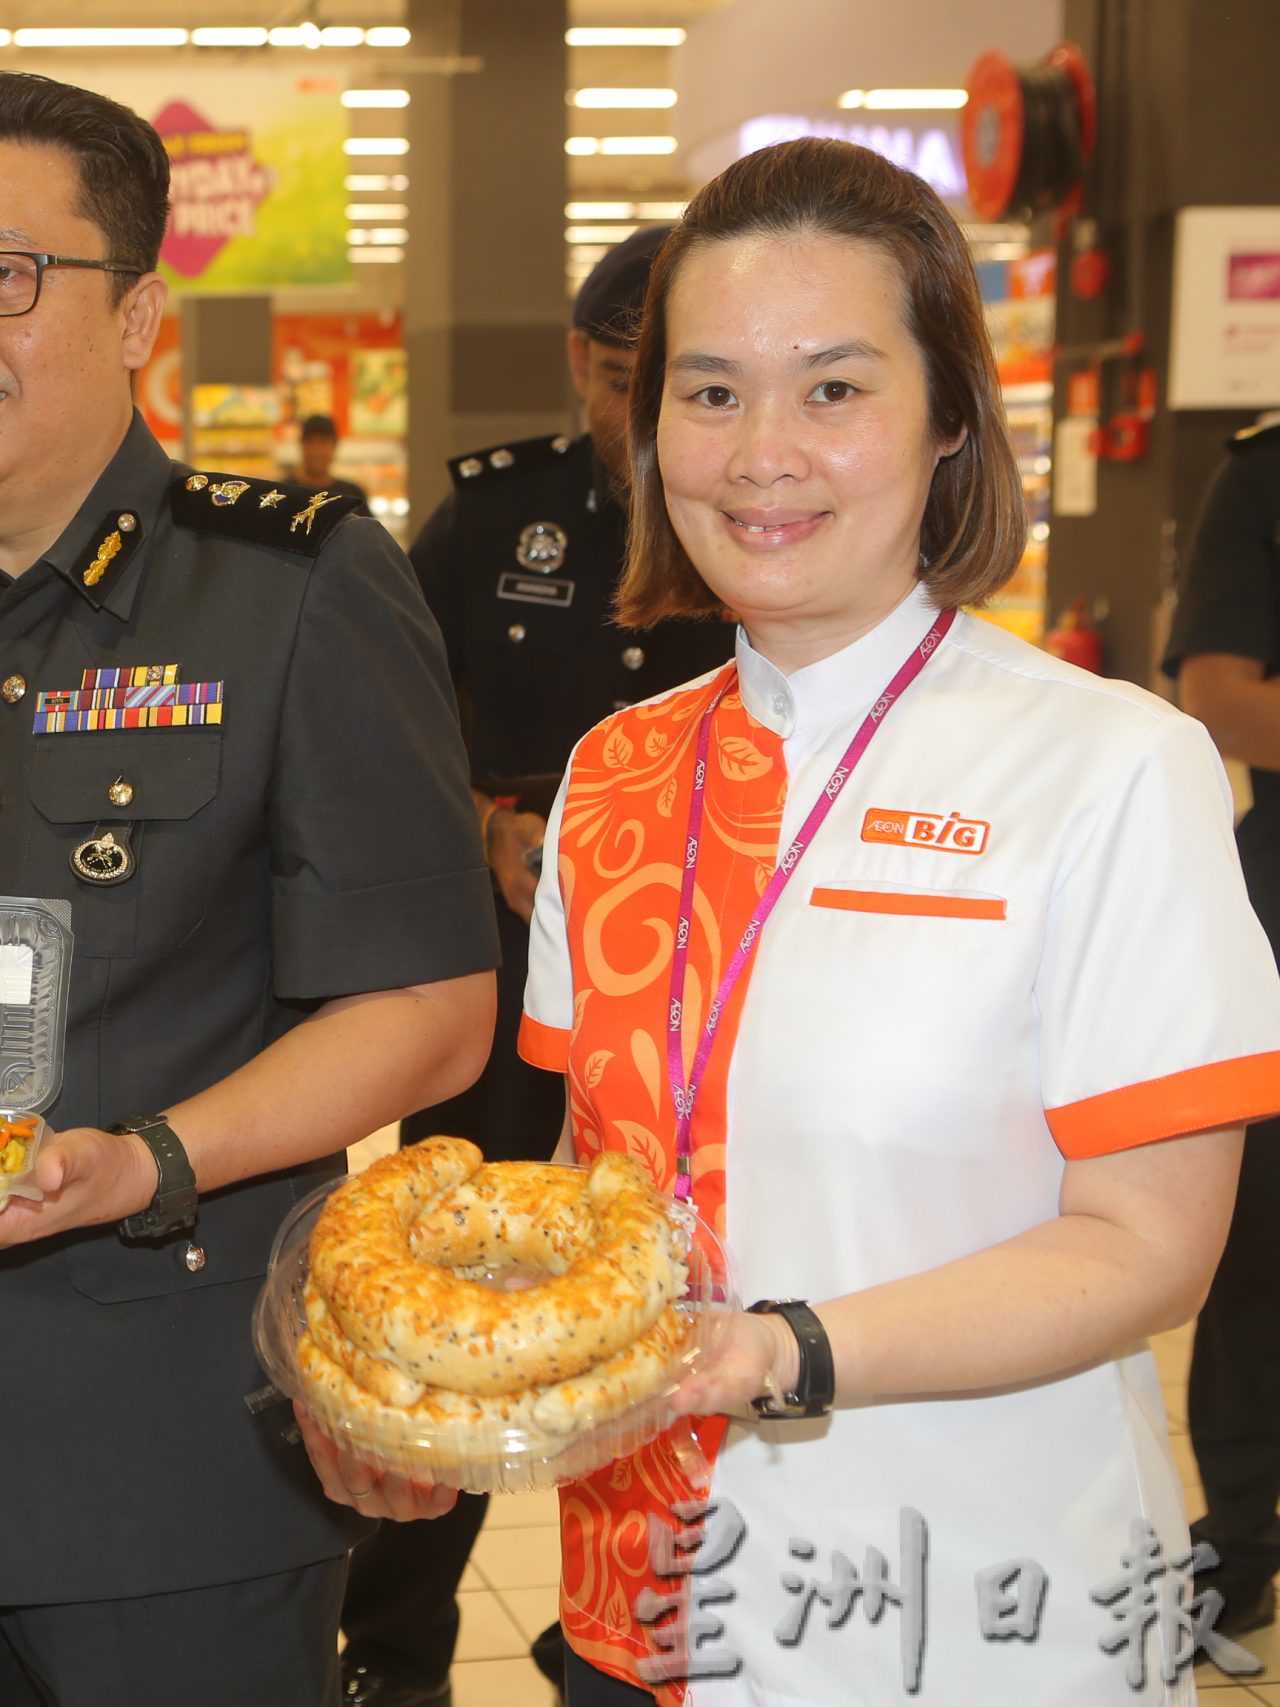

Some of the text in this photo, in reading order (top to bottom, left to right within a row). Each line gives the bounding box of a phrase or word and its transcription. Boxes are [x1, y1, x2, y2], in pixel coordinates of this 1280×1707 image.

[919, 629, 942, 659] AEON
[869, 692, 895, 724] AEON
[694, 759, 706, 791] AEON
[825, 765, 850, 800] AEON
[866, 819, 905, 834] AEON
[685, 836, 698, 869] AEON
[780, 841, 805, 876] AEON
[676, 916, 690, 950] AEON
[739, 919, 761, 955] AEON
[670, 997, 682, 1032] AEON
[705, 999, 722, 1036] AEON
